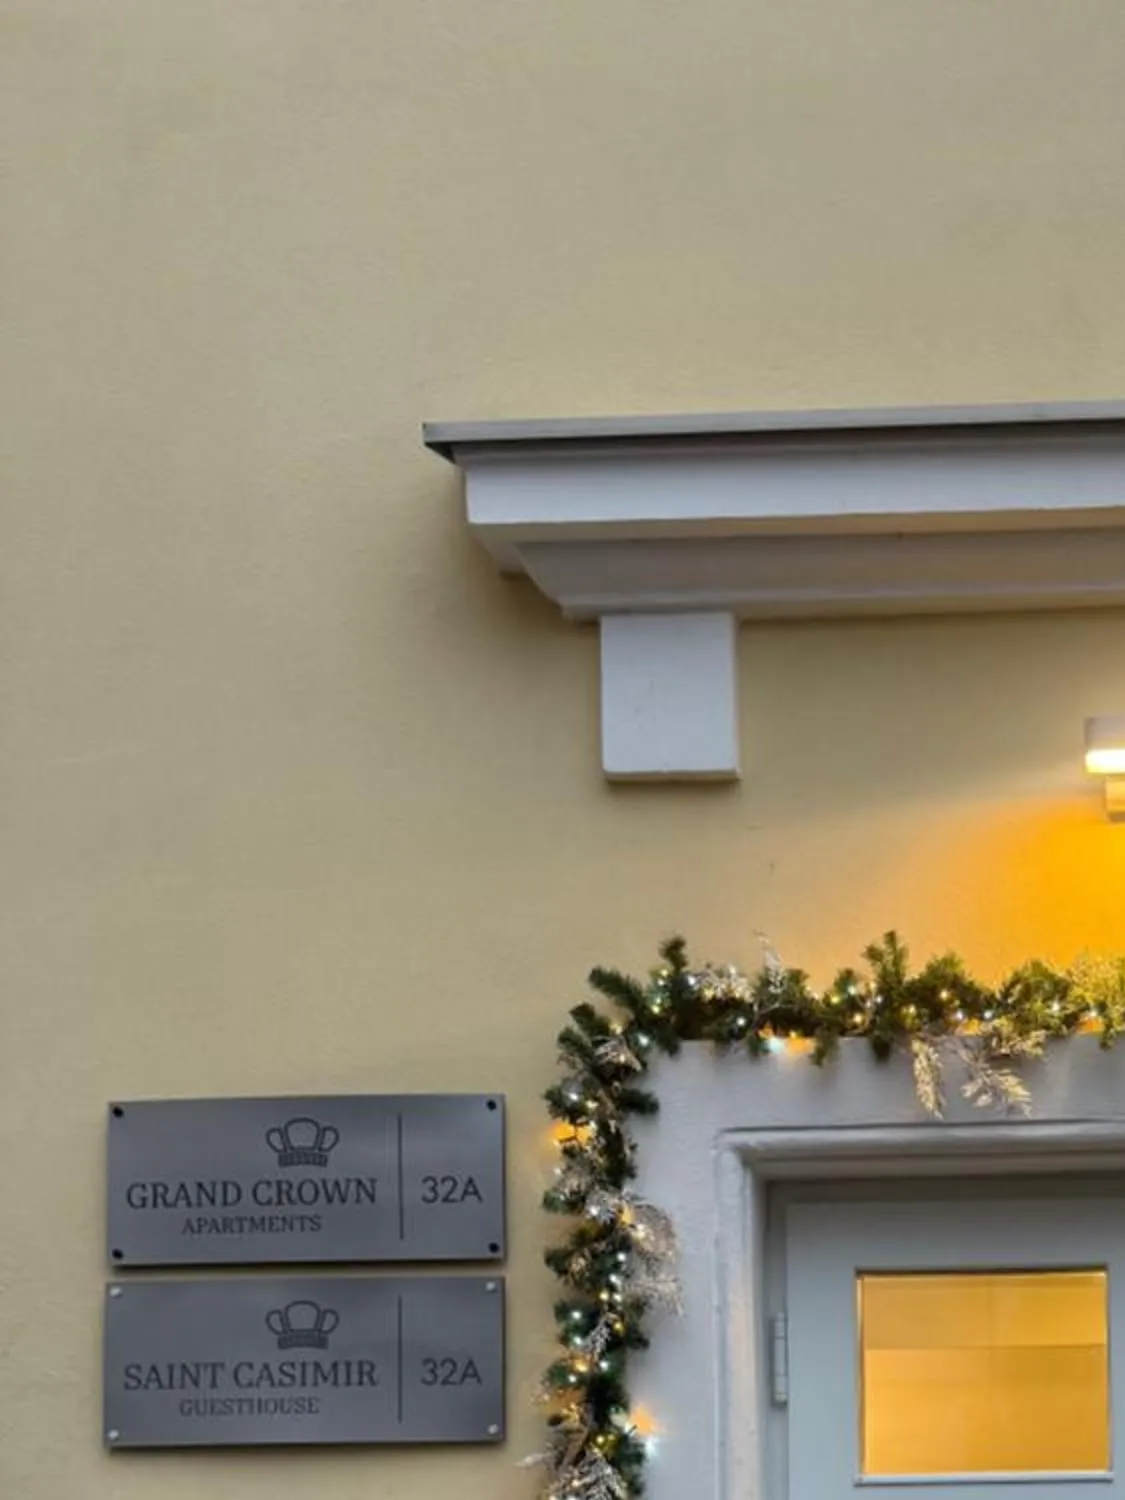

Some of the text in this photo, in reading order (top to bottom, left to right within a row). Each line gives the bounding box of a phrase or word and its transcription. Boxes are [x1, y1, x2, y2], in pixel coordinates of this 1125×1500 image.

[125, 1178, 378, 1210] GRAND CROWN
[421, 1176, 483, 1204] 32A
[182, 1214, 322, 1236] APARTMENTS
[123, 1359, 379, 1391] SAINT CASIMIR
[420, 1357, 483, 1387] 32A
[179, 1397, 320, 1418] GUESTHOUSE
